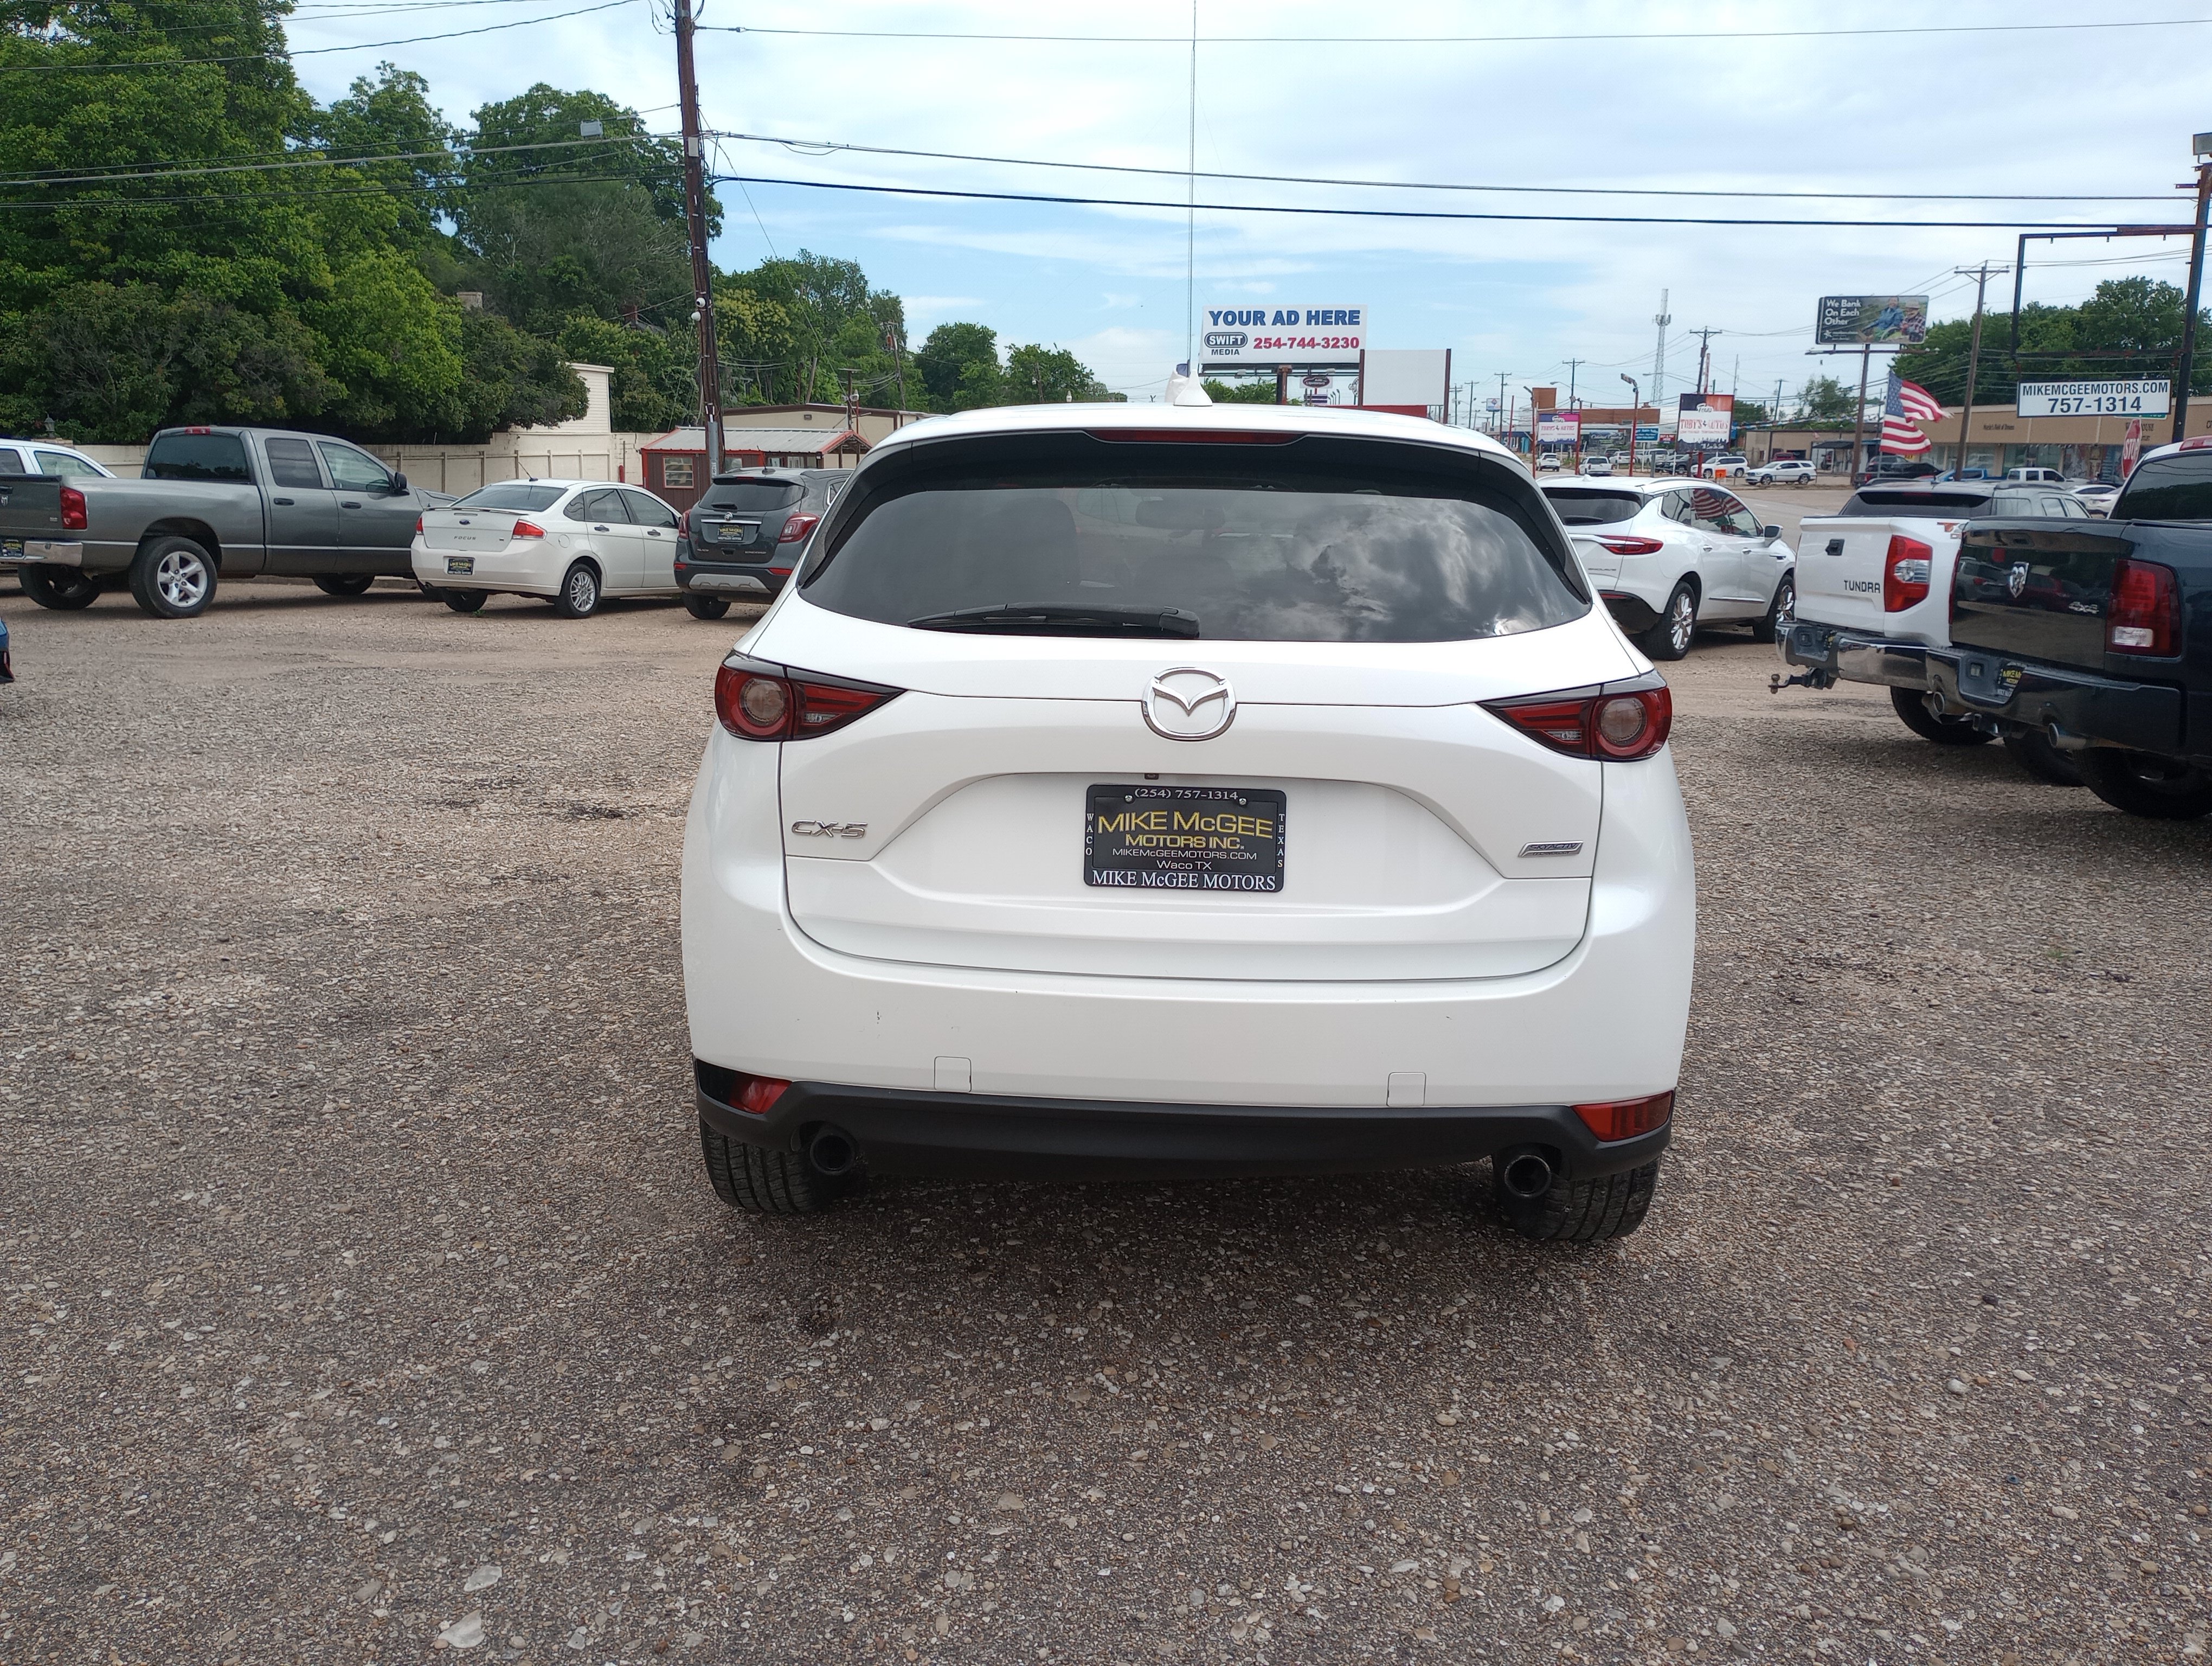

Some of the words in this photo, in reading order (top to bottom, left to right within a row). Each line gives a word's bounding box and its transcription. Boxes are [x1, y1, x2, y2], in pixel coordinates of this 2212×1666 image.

[1827, 299, 1840, 307] We
[1841, 299, 1862, 307] Bank
[1208, 310, 1266, 326] YOUR
[1271, 310, 1299, 325] AD
[1306, 310, 1360, 325] HERE
[1841, 308, 1860, 316] Each
[1824, 317, 1849, 325] Other
[1209, 335, 1243, 345] SWIFT
[1253, 337, 1359, 349] 254-744-3230
[2022, 382, 2168, 396] MIKEMCGEEMOTORS.COM
[2048, 396, 2142, 413] 757-1314
[1843, 580, 1880, 593] TUNDRA
[1135, 789, 1171, 798] (254)
[1175, 790, 1238, 799] 757-1314
[792, 819, 867, 838] CX-5
[1098, 811, 1167, 834] MIKE
[1174, 811, 1273, 839] McGEE
[1085, 813, 1094, 856] WACO
[1276, 813, 1284, 868] TEXAS
[1126, 834, 1206, 848] MOTORS
[1209, 836, 1244, 850] INC.
[1156, 860, 1193, 869] Waco
[1195, 861, 1212, 870] TX
[1092, 870, 1137, 885] MIKE
[1141, 872, 1198, 887] McGEE
[1203, 874, 1276, 890] MOTORS
